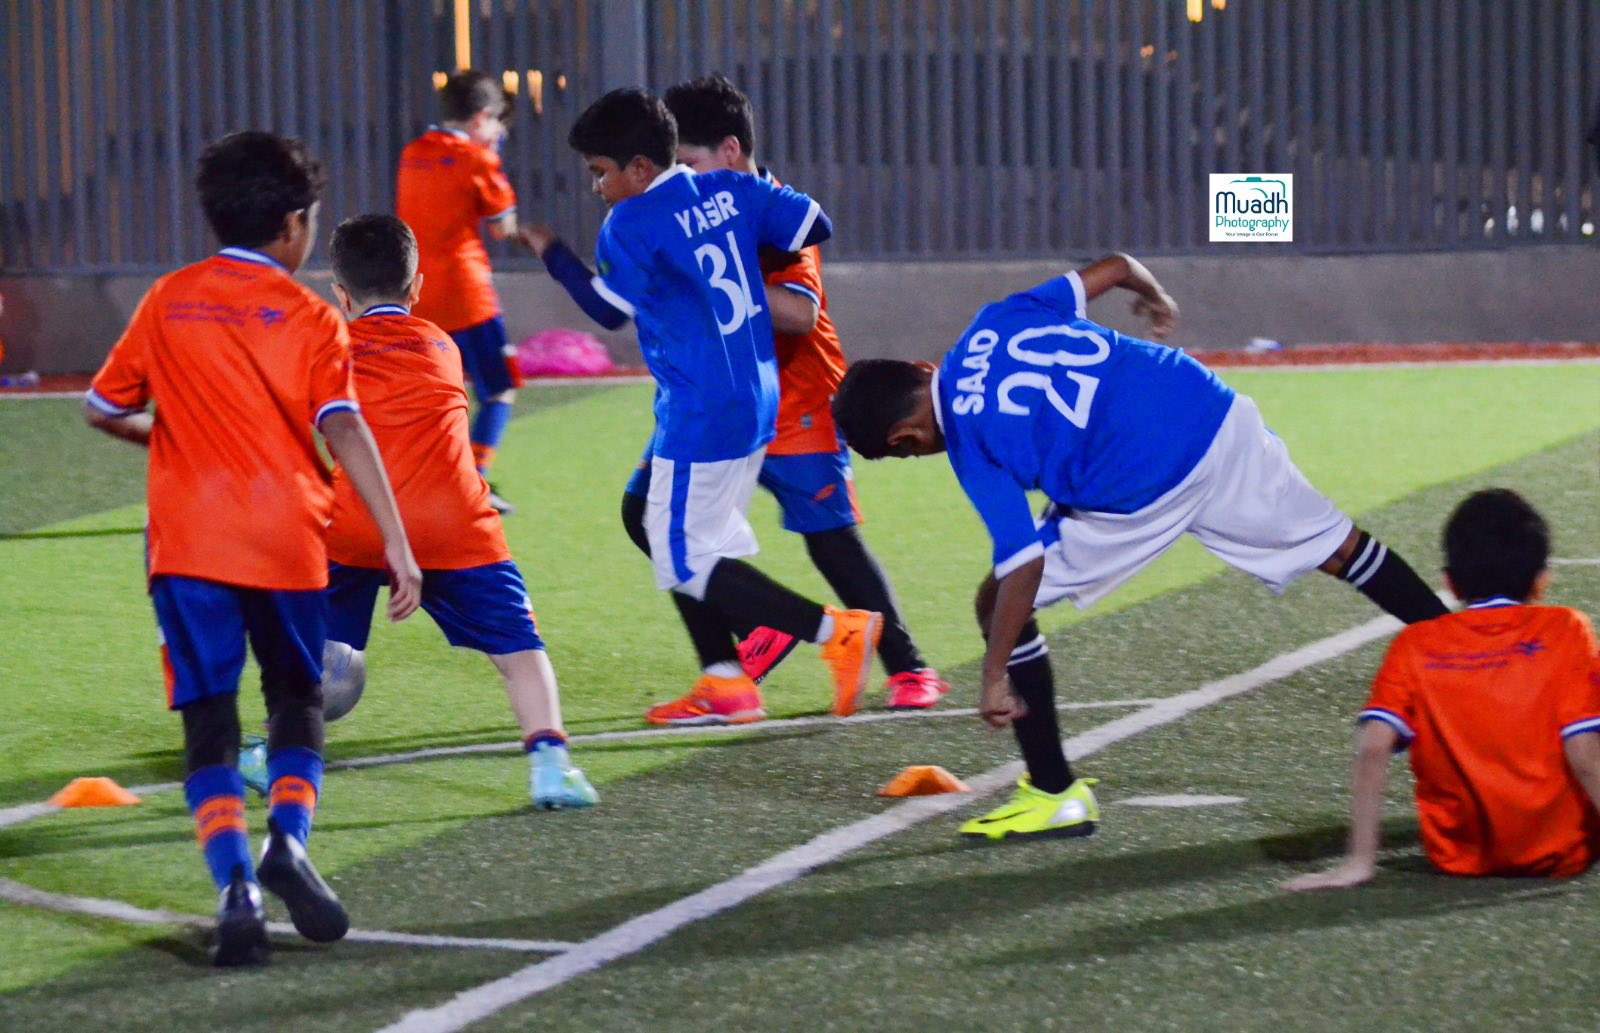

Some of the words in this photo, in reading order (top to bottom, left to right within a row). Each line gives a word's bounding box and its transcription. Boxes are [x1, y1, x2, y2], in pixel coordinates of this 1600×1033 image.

[693, 230, 763, 335] 31
[952, 328, 1000, 416] SAAD
[997, 324, 1111, 430] 20
